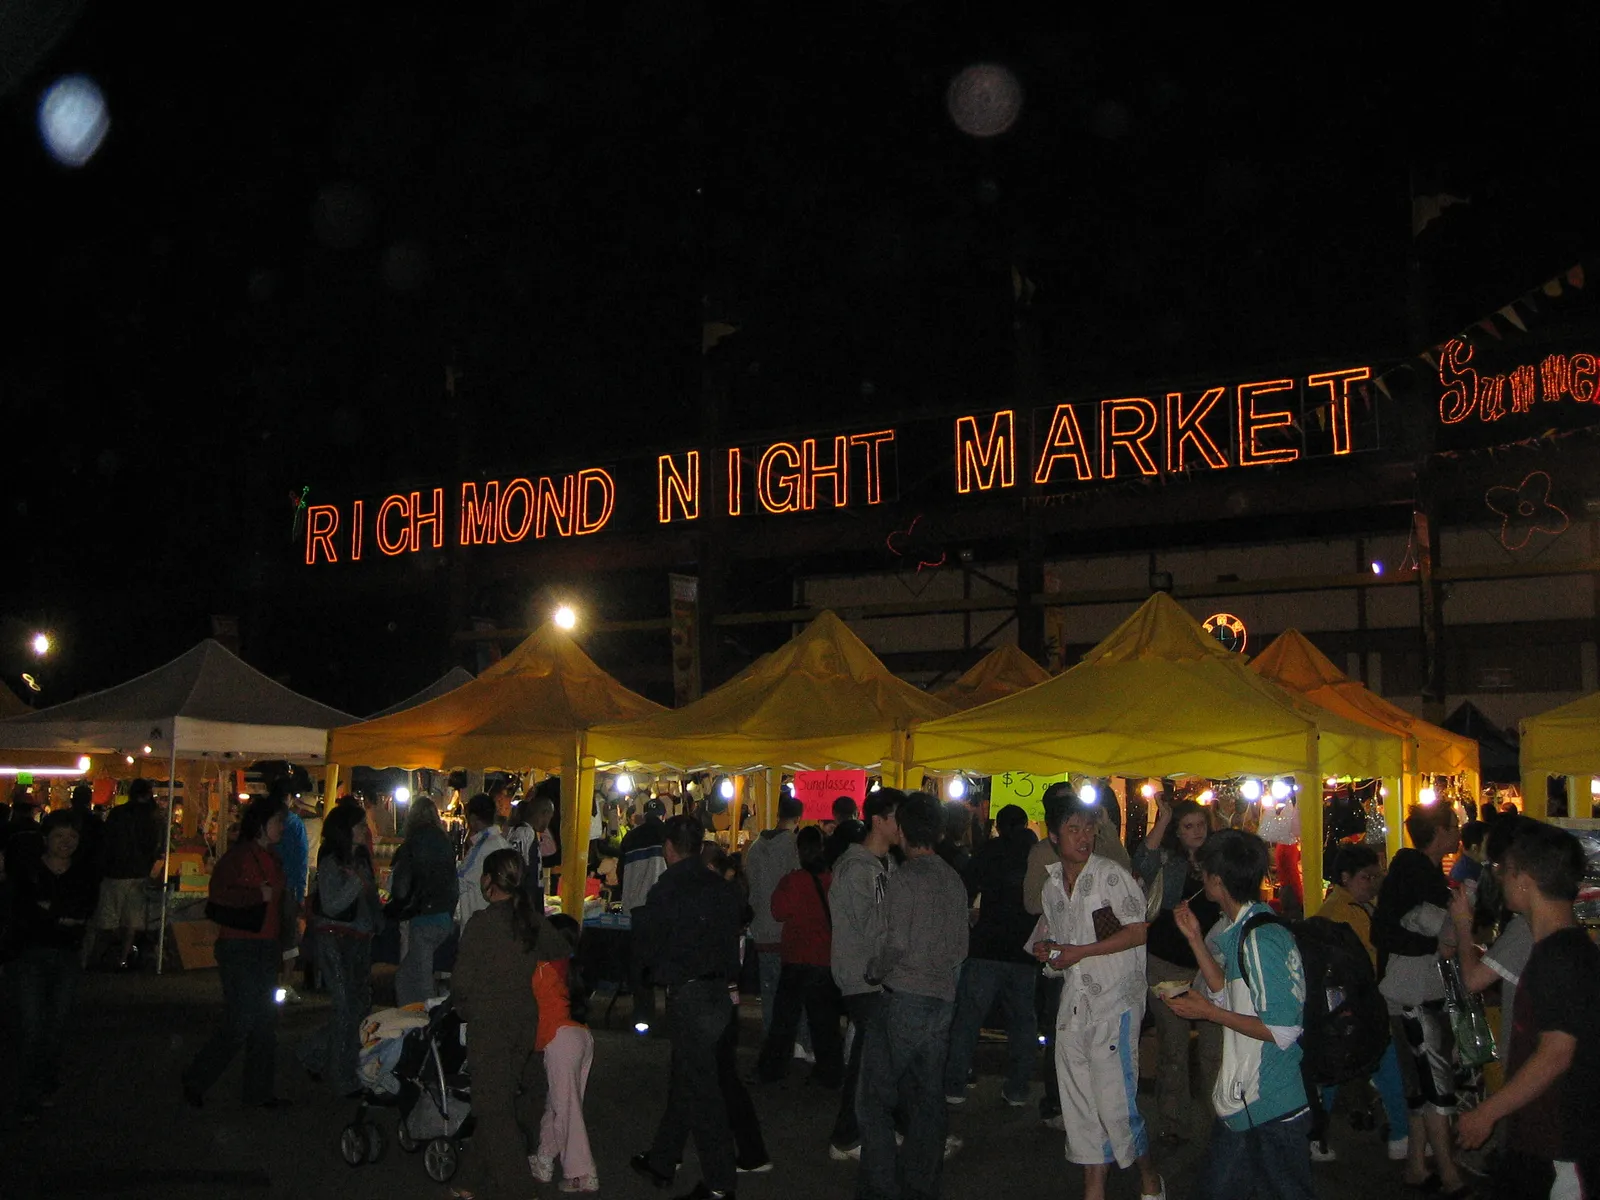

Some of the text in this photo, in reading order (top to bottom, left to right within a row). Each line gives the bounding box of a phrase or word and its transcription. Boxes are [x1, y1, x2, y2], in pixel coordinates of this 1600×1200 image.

[305, 366, 1371, 565] RICHMOND NIGHT MARKET
[799, 773, 856, 797] Sunglasses
